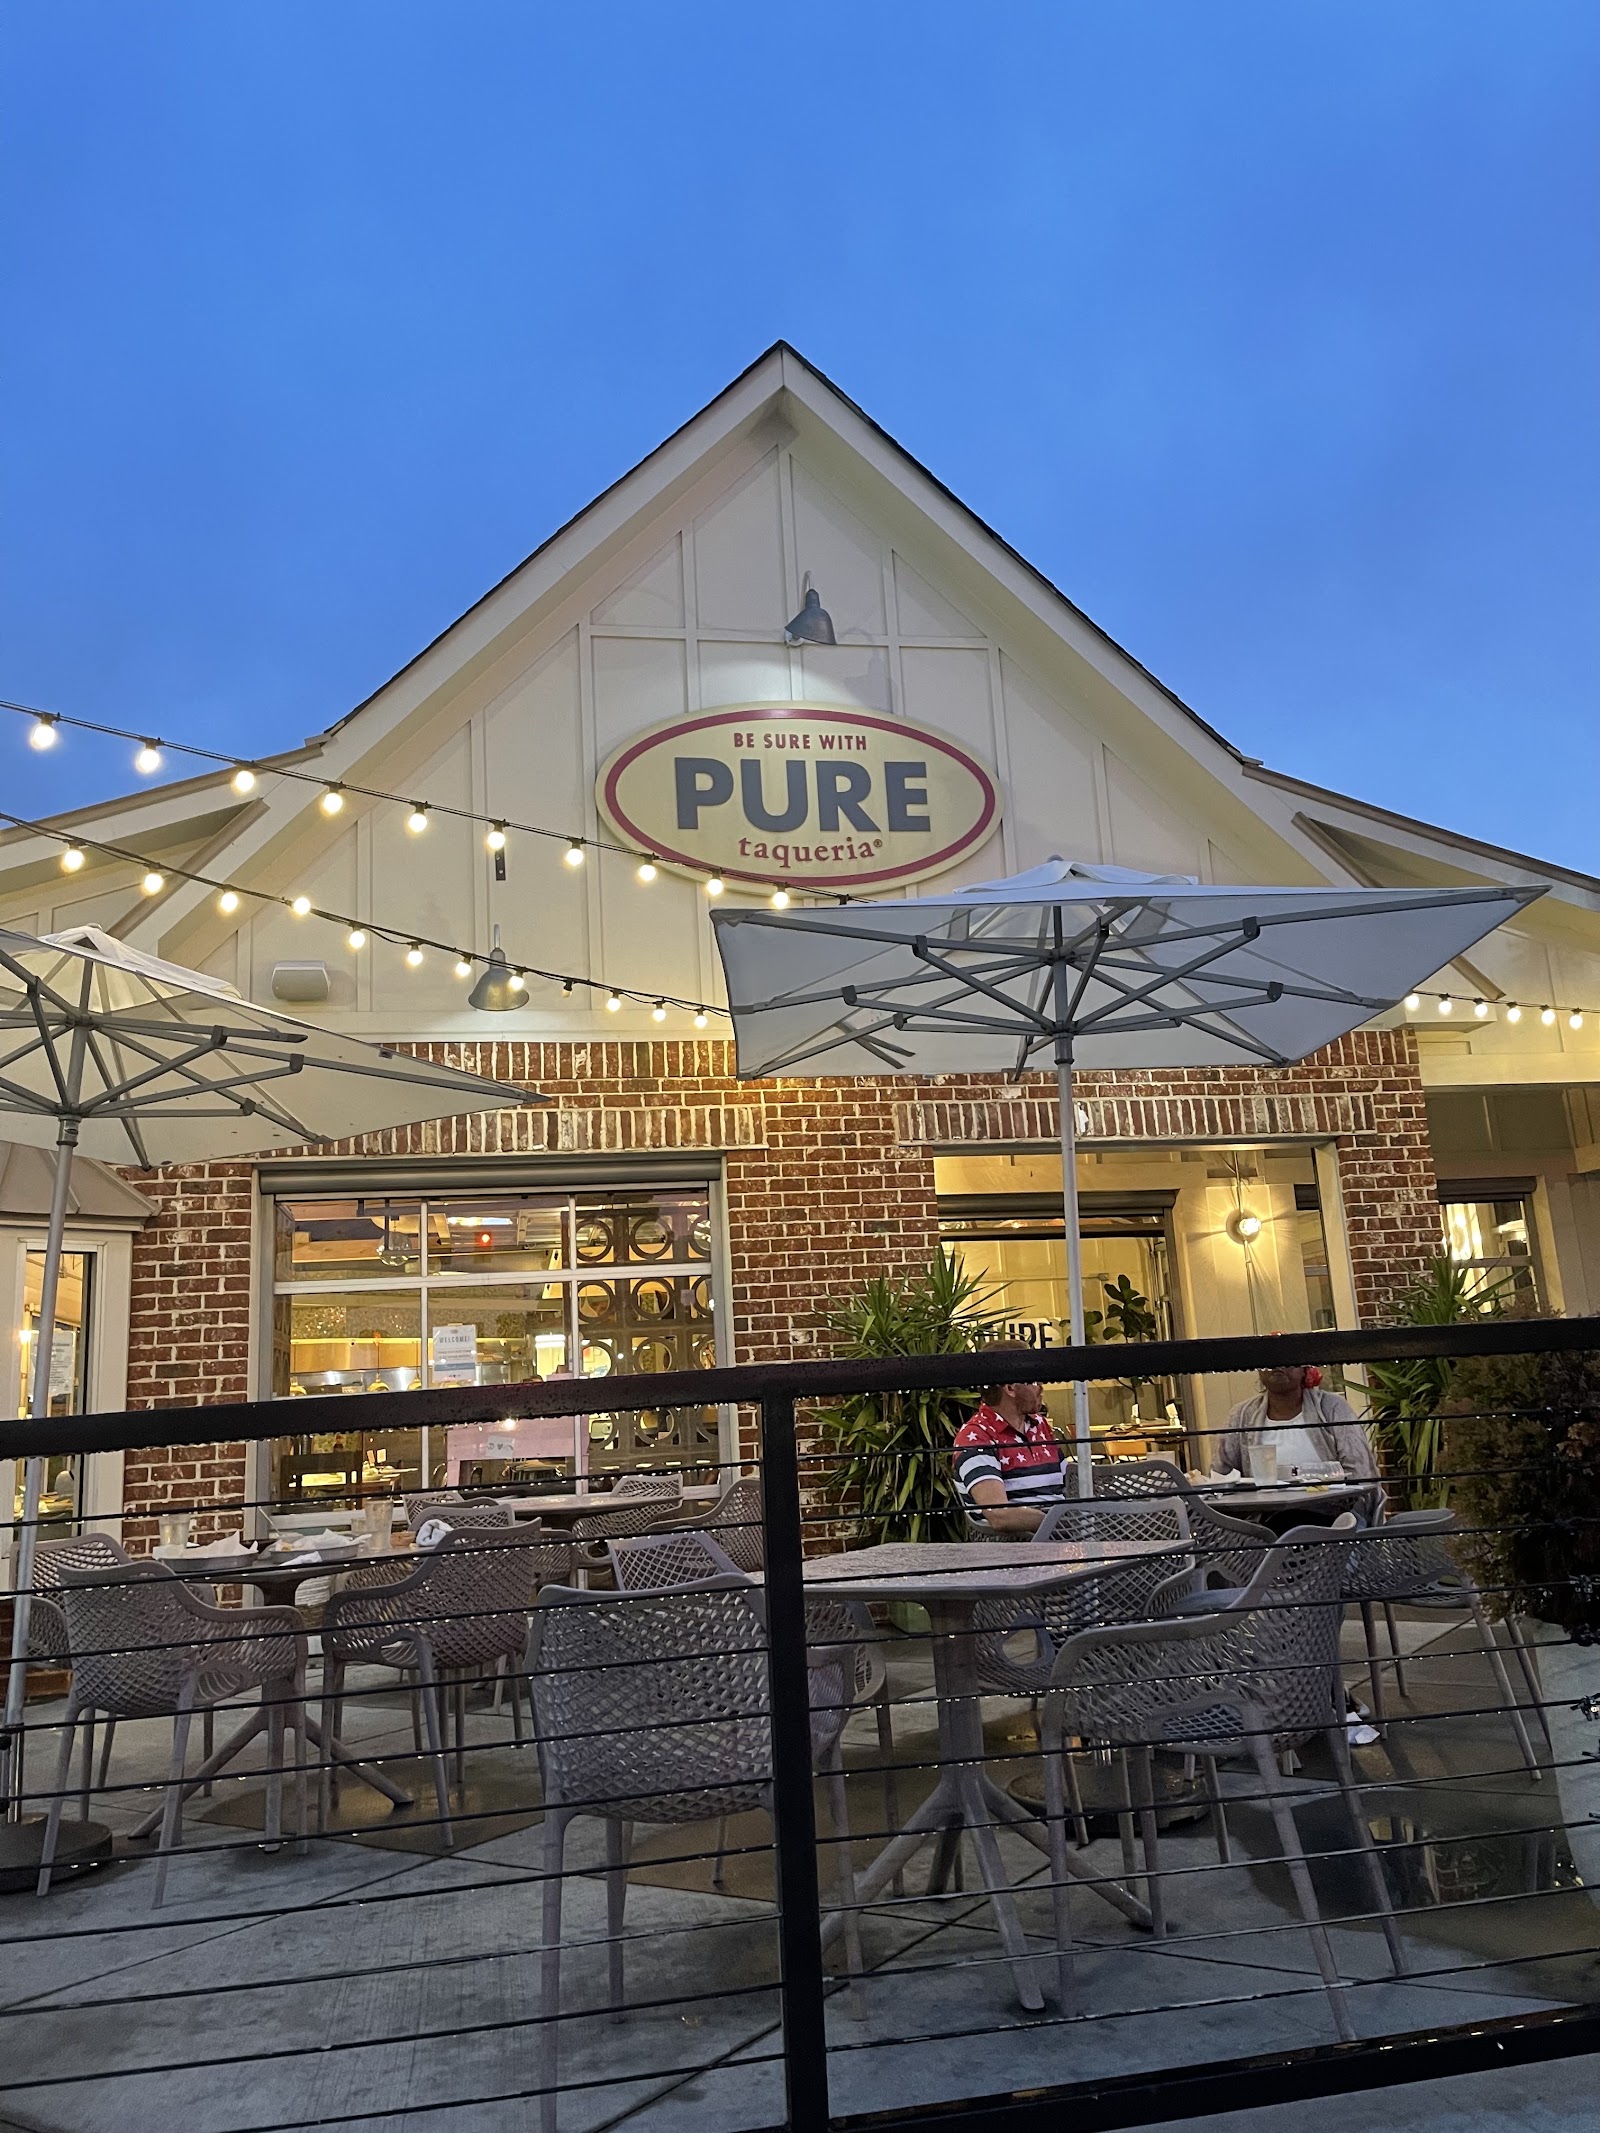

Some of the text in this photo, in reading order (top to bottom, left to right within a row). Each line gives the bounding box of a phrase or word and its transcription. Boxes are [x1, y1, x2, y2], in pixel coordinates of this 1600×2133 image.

[734, 733, 867, 750] BE SURE WITH
[674, 757, 931, 832] PURE
